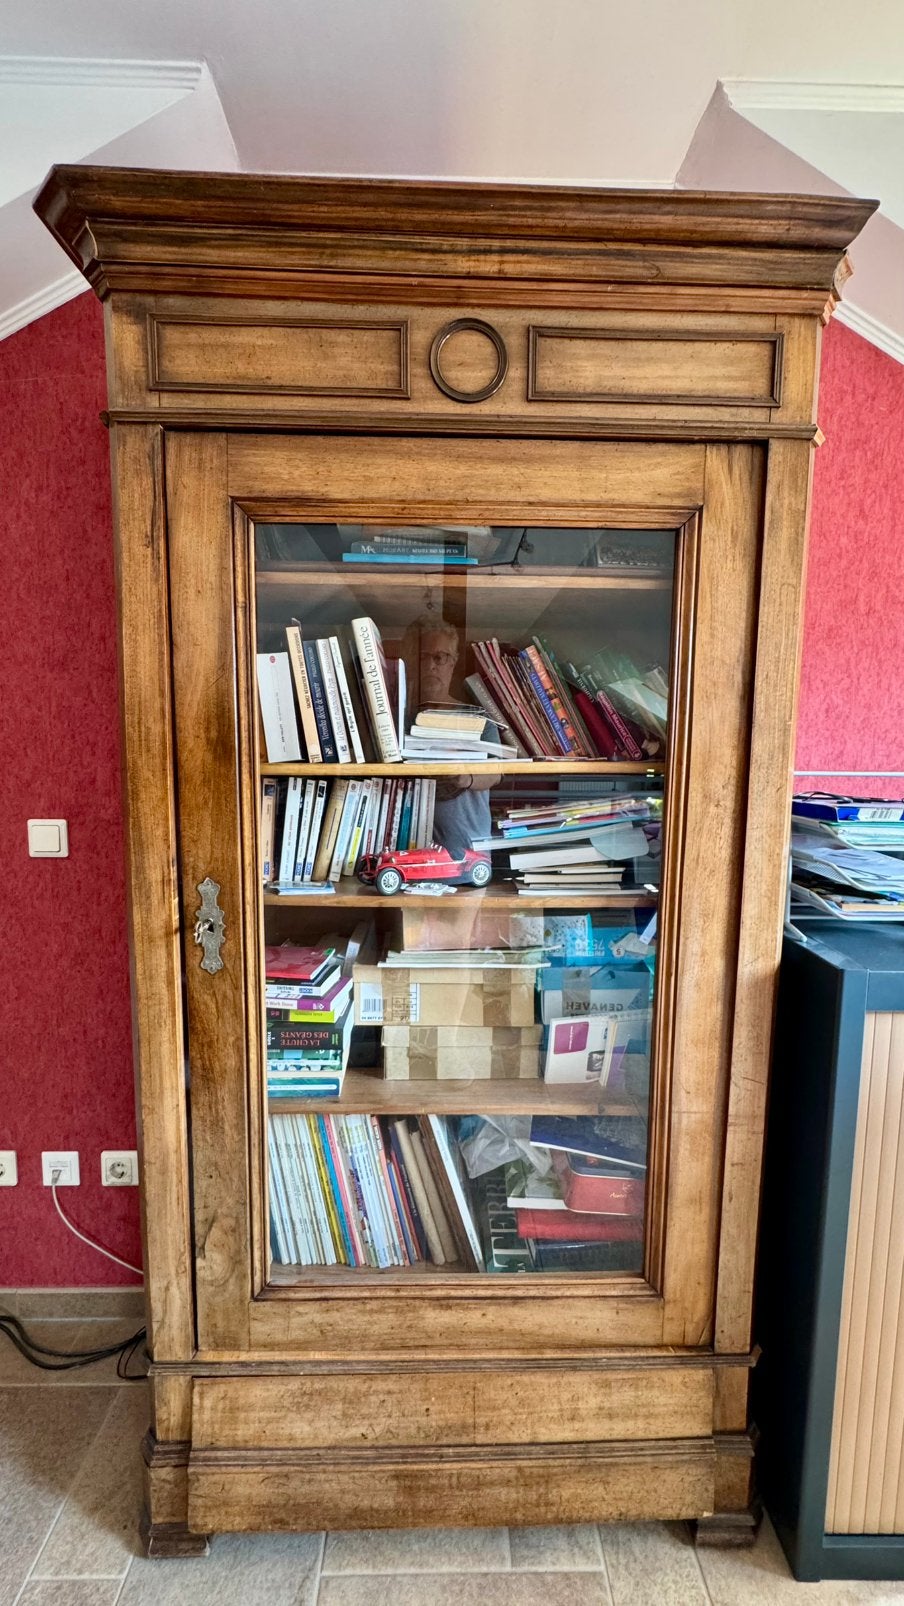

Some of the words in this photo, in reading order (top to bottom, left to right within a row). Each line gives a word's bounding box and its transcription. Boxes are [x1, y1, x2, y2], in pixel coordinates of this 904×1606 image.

[360, 626, 374, 663] l'année
[366, 663, 378, 678] de
[314, 697, 323, 706] de
[368, 678, 387, 716] Journal
[319, 719, 330, 741] Veronika
[609, 712, 628, 737] Maurice
[280, 1031, 312, 1039] GÉANTS
